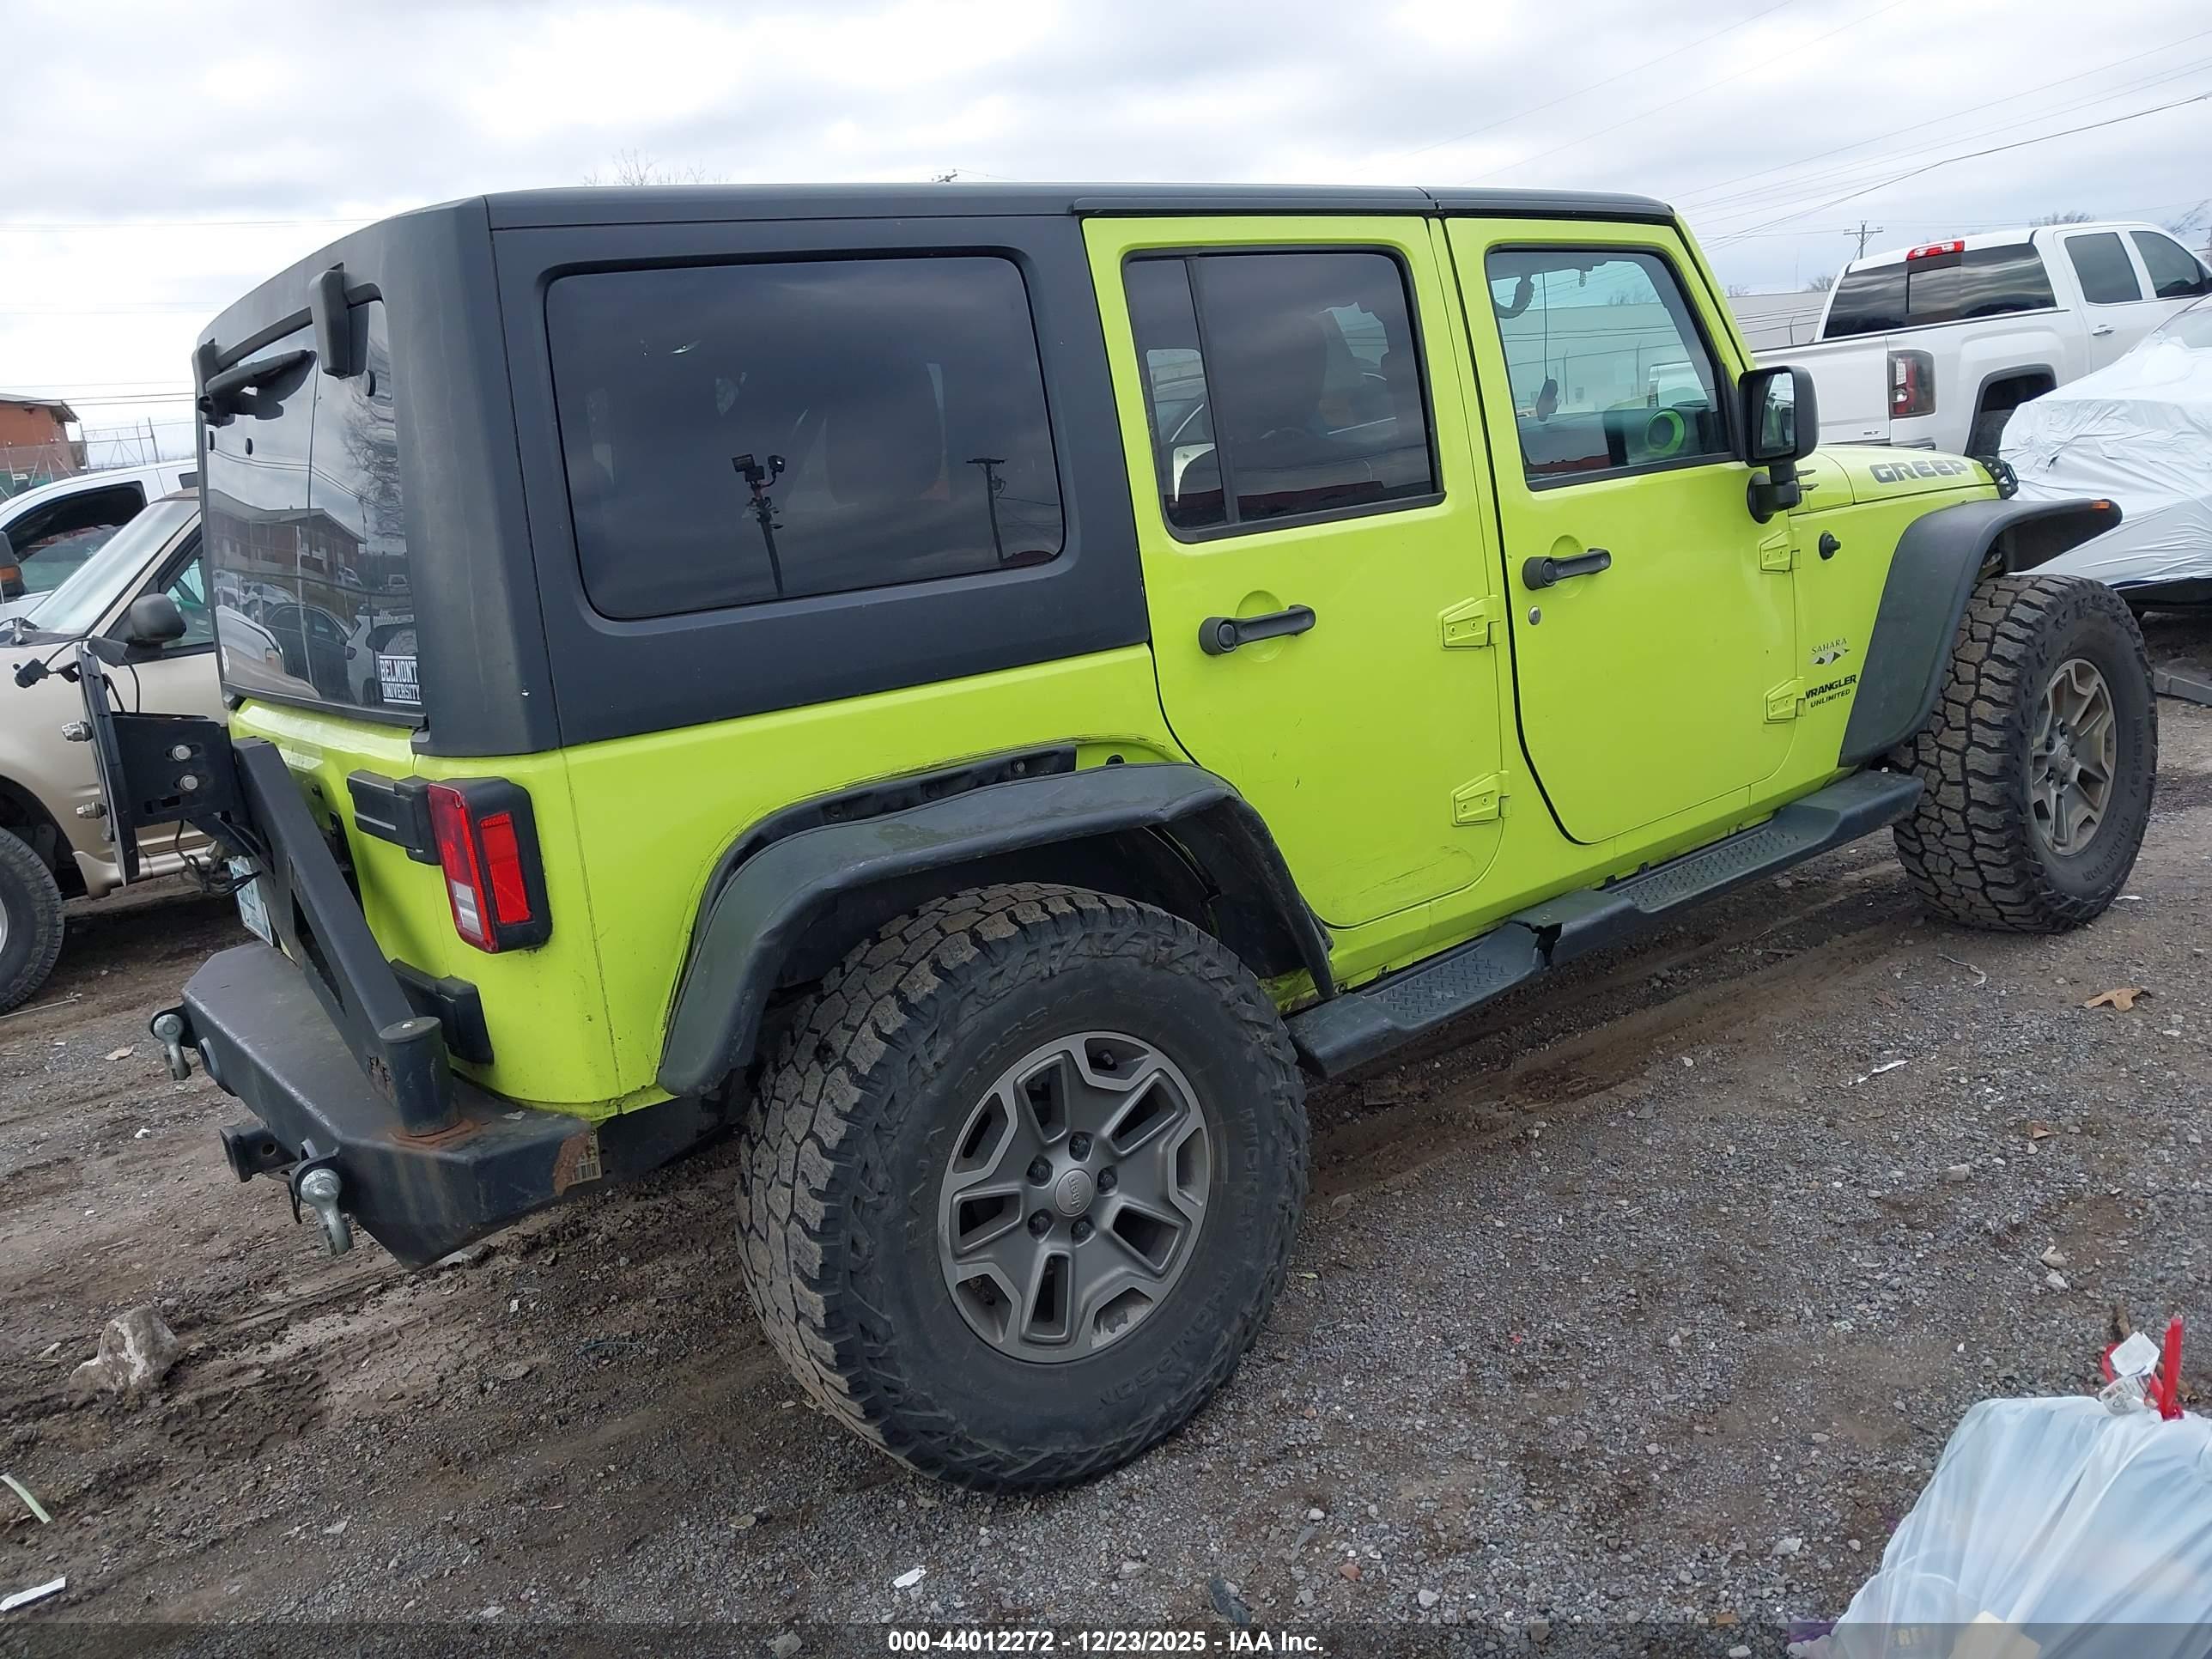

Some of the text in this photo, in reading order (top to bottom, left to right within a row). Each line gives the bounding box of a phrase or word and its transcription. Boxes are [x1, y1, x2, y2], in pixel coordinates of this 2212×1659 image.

[1869, 459, 1968, 483] GREEP
[1811, 638, 1847, 654] SAHARA
[379, 659, 418, 684] BELMONT
[381, 683, 420, 701] UNIVERSITY
[1810, 689, 1850, 708] UNLIMITED
